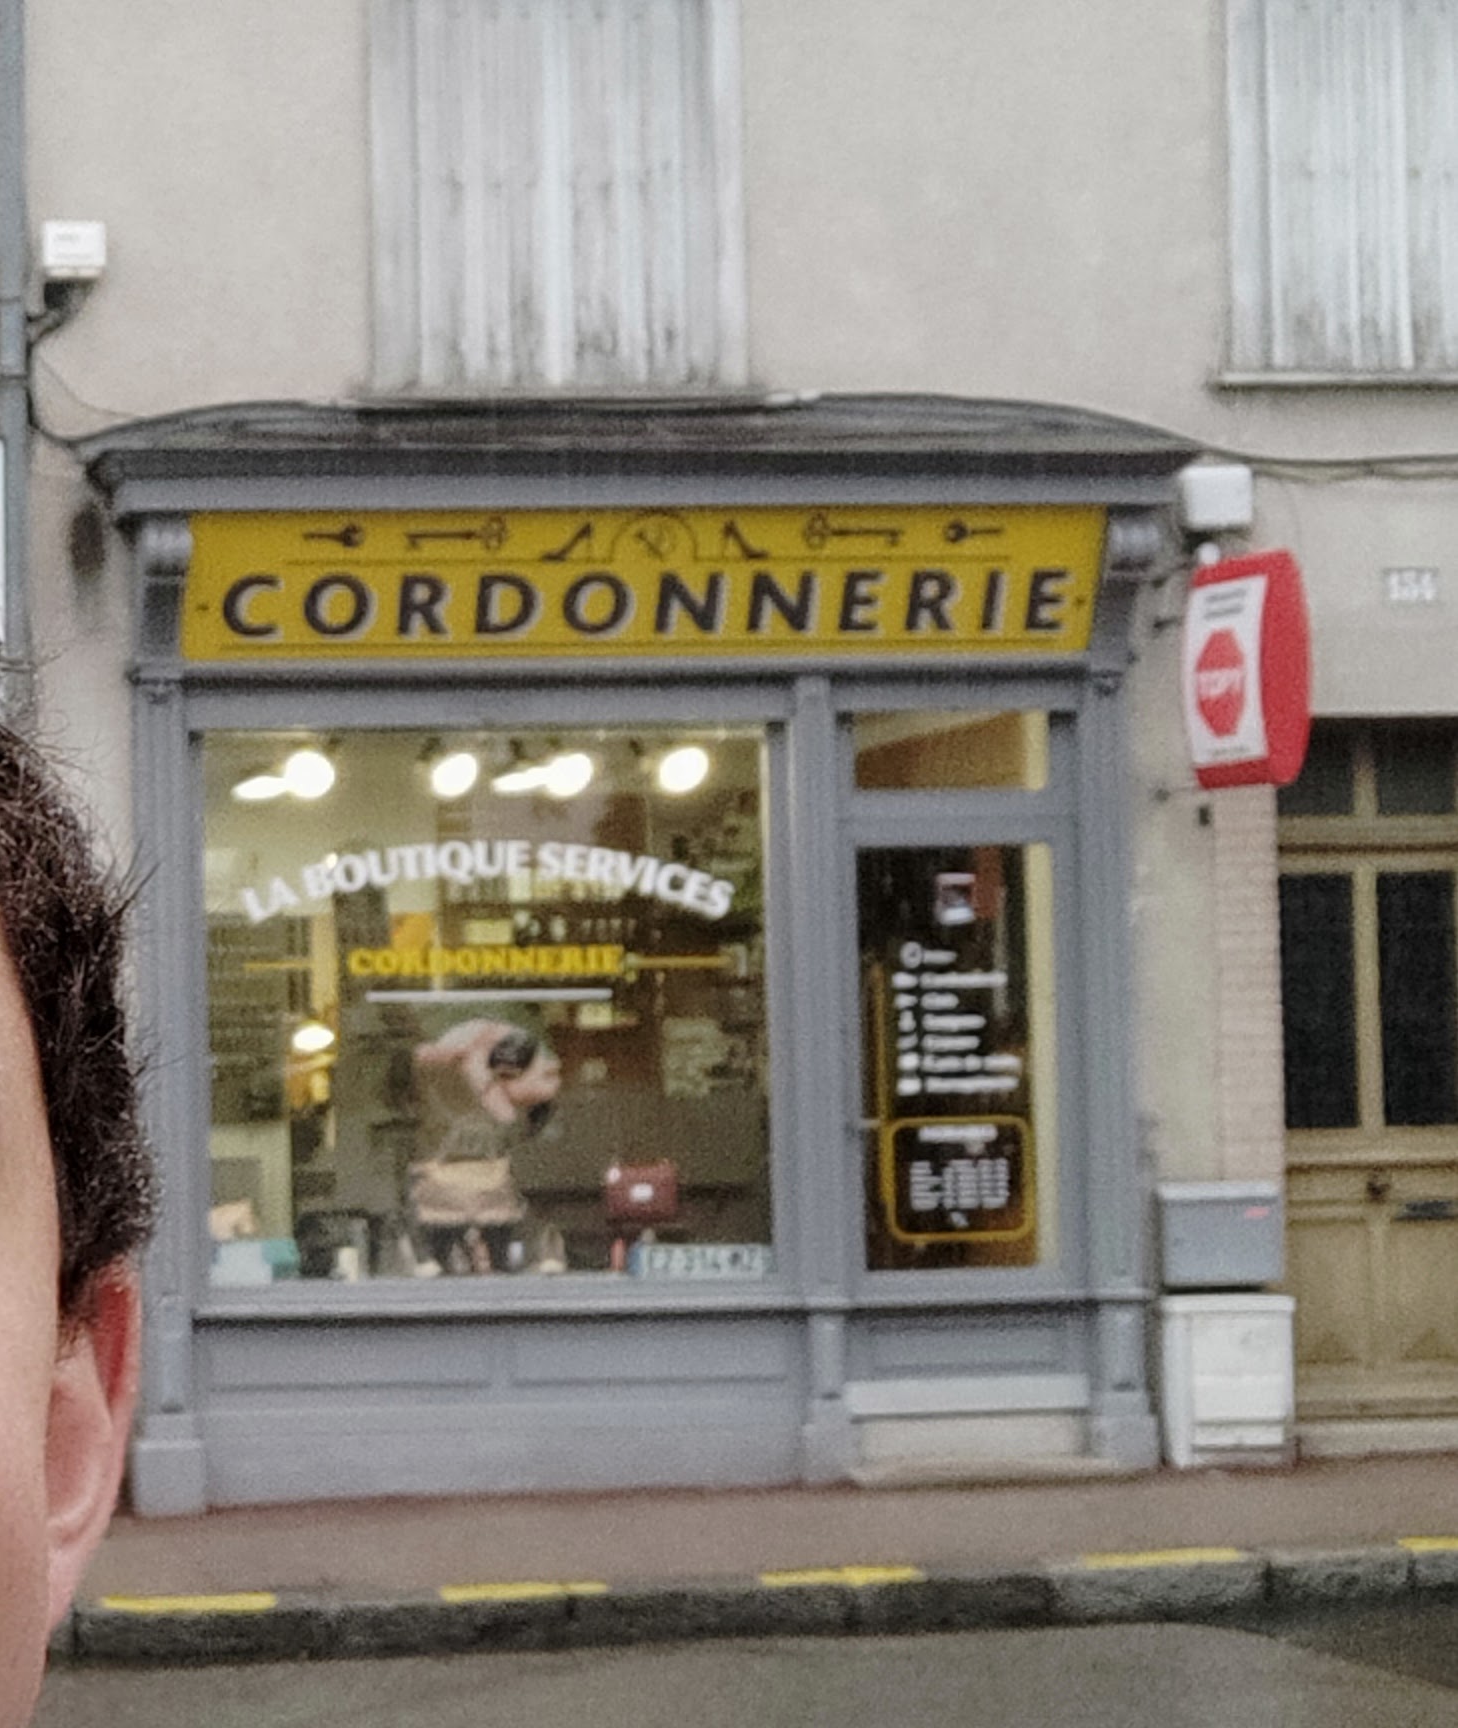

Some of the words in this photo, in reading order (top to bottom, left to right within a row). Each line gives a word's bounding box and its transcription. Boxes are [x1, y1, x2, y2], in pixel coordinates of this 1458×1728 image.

[221, 567, 1074, 639] CORDONNERIE
[243, 877, 299, 924] LA
[302, 839, 531, 900] BOUTIQUE
[536, 841, 735, 920] SERVICES
[347, 943, 626, 978] CORDONNERIE
